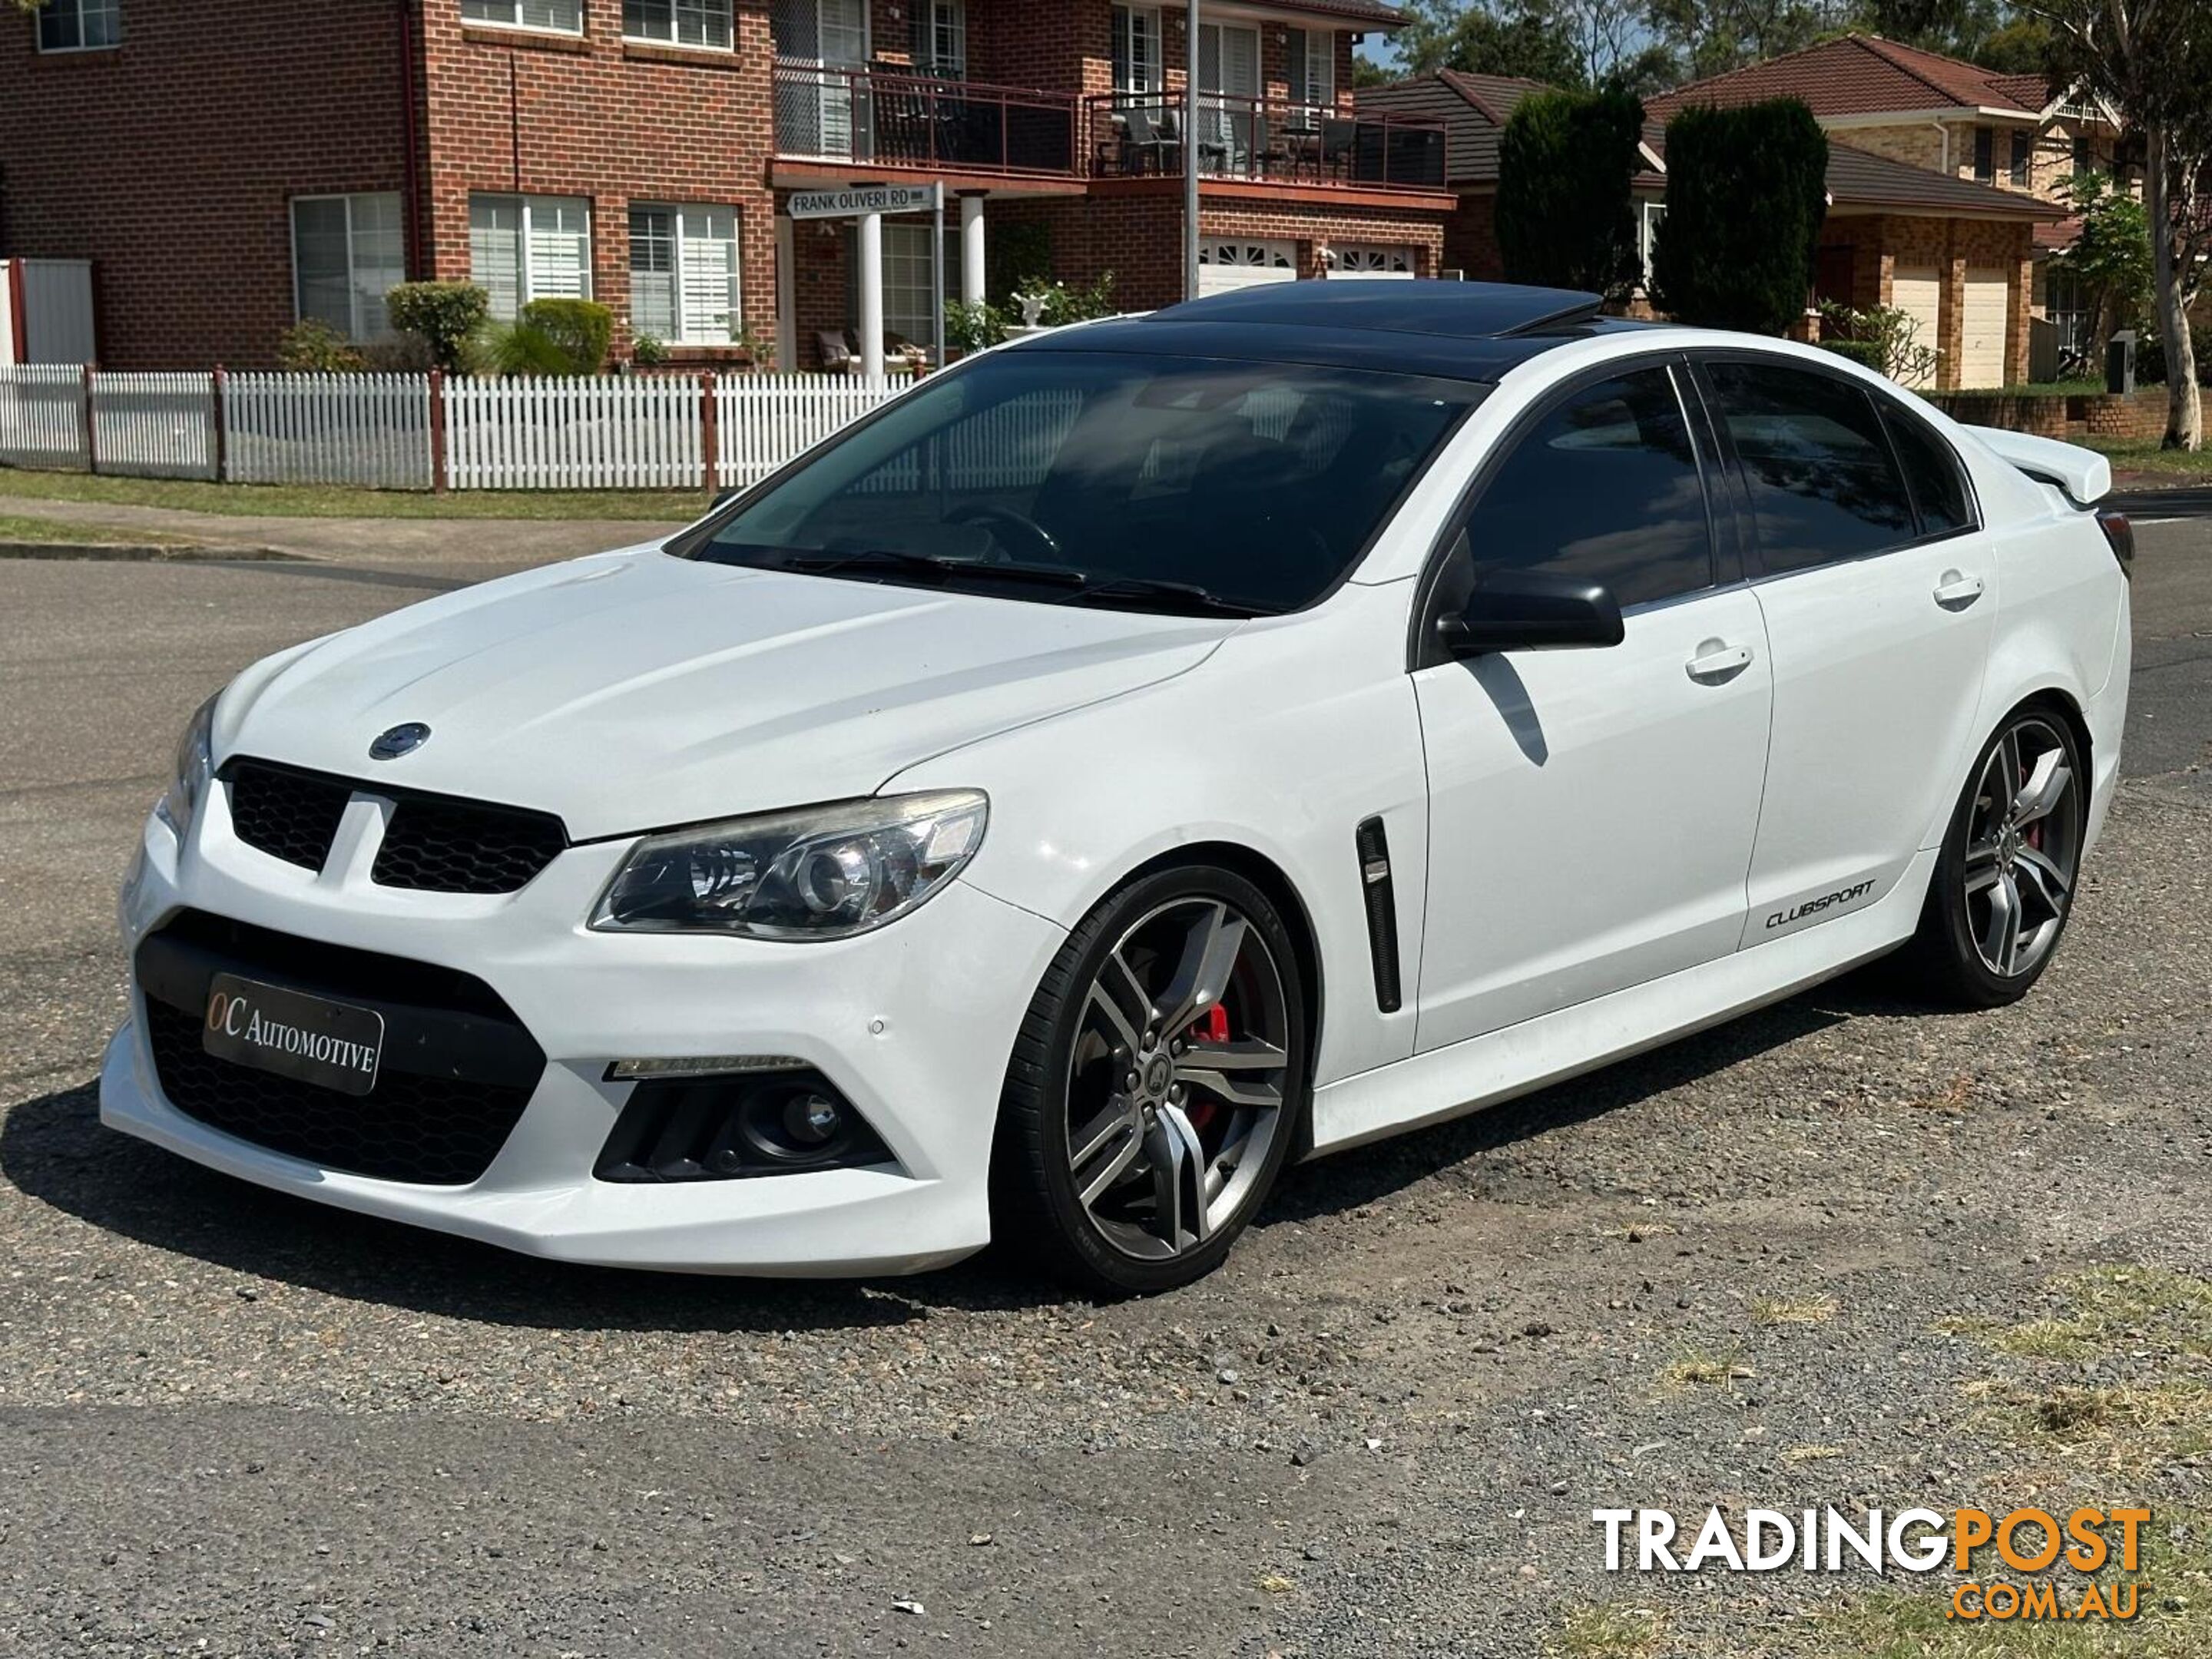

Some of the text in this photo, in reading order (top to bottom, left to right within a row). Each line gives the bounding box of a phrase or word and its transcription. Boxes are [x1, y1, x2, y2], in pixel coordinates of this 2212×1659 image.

[794, 189, 909, 211] FRANK OLIVERI RD
[1766, 879, 1876, 929] CLUBSPORT
[208, 992, 376, 1073] OC AUTOMOTIVE
